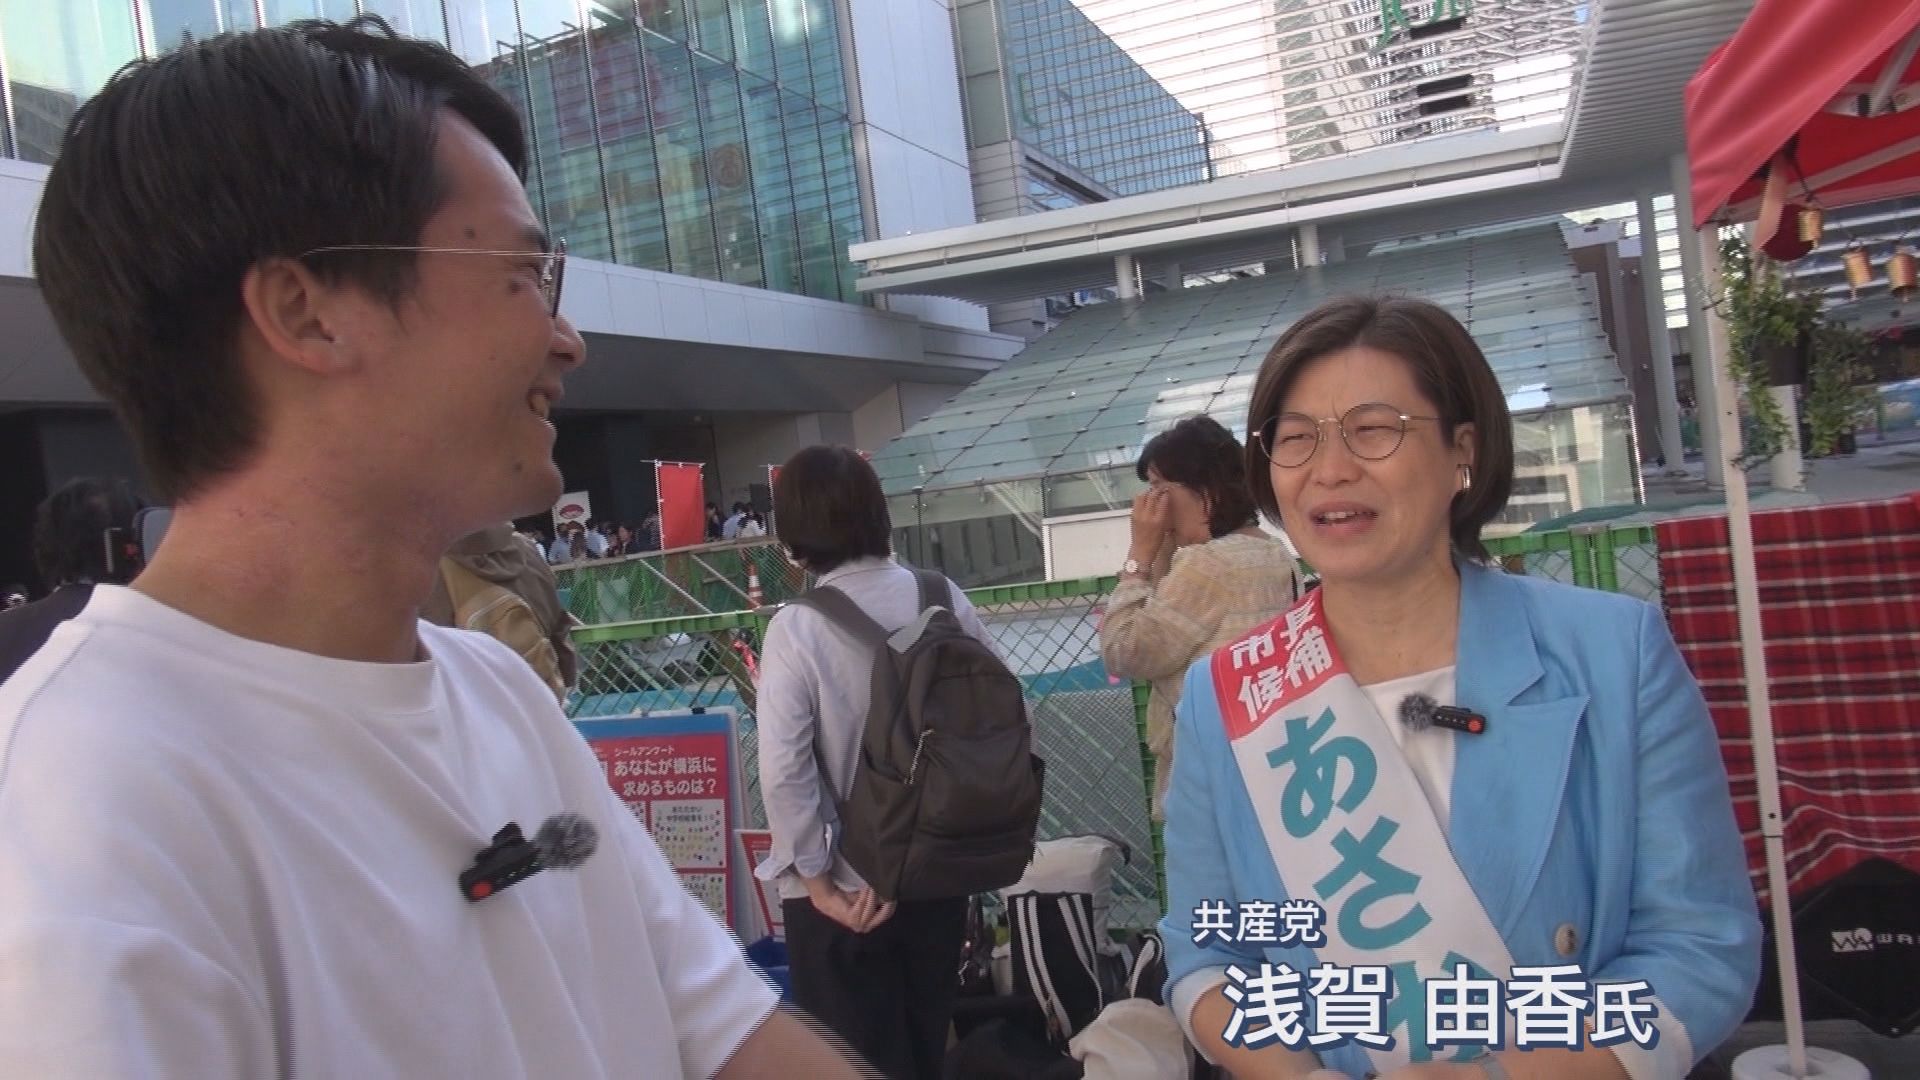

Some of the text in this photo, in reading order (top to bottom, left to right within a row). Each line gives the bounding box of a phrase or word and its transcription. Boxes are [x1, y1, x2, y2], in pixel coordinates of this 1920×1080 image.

[1228, 595, 1317, 671] 市長
[1238, 625, 1334, 723] 候補
[614, 756, 718, 778] あなたが横浜に
[1876, 933, 1920, 945] WA
